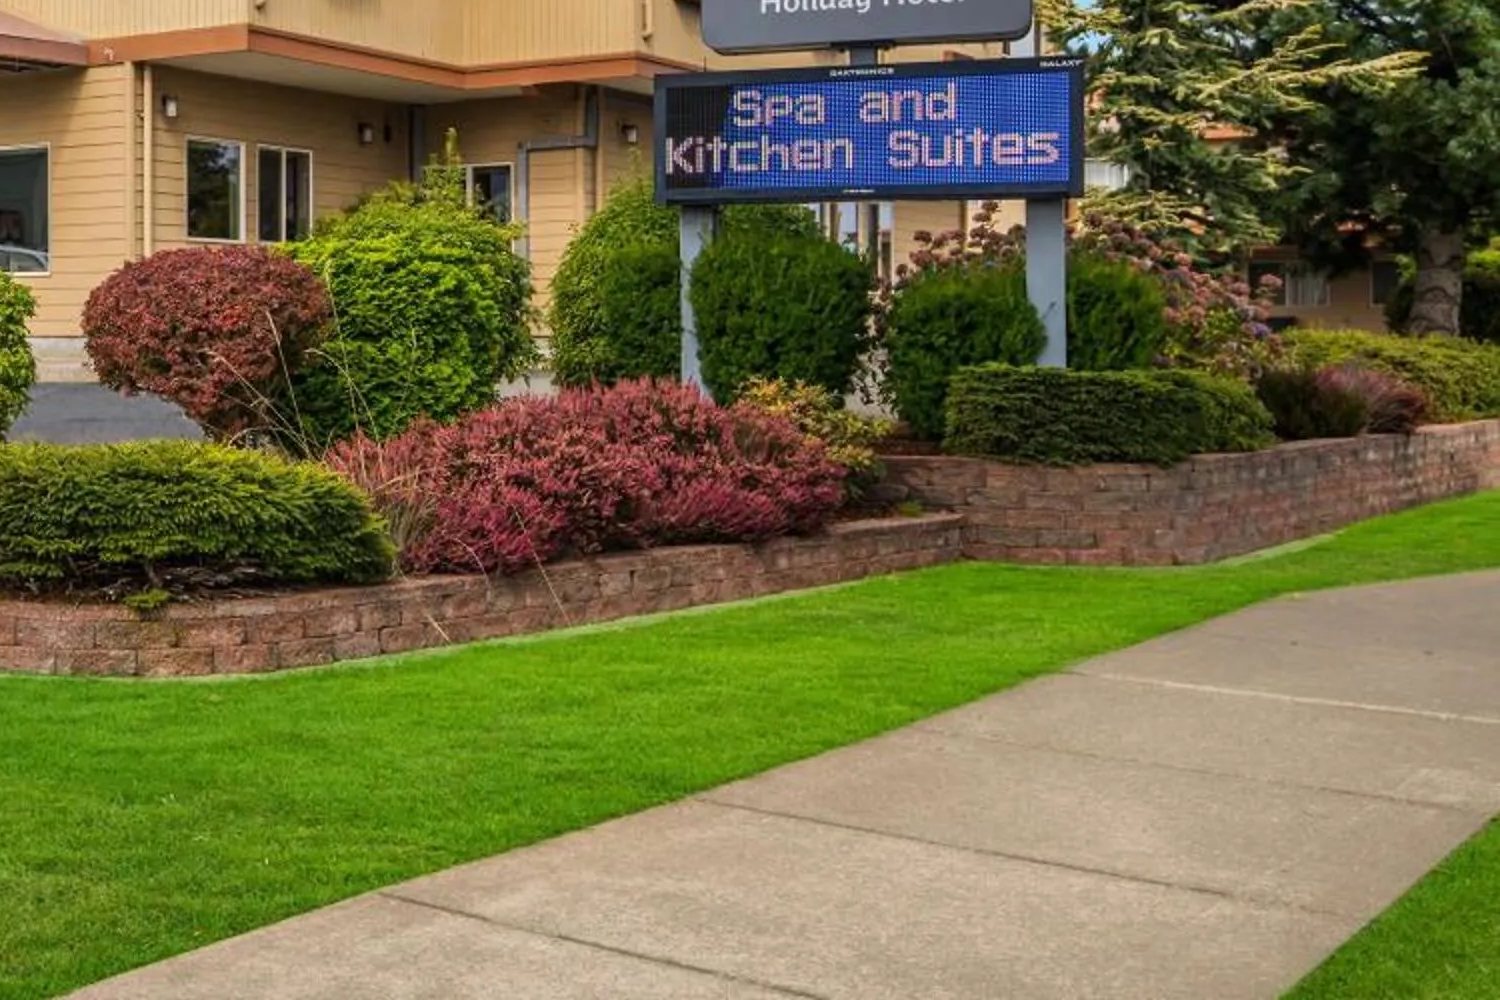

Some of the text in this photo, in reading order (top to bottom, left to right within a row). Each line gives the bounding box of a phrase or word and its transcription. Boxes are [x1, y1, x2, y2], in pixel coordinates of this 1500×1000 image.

[732, 81, 957, 128] Spa and
[664, 126, 1061, 175] Kitchen Suites
